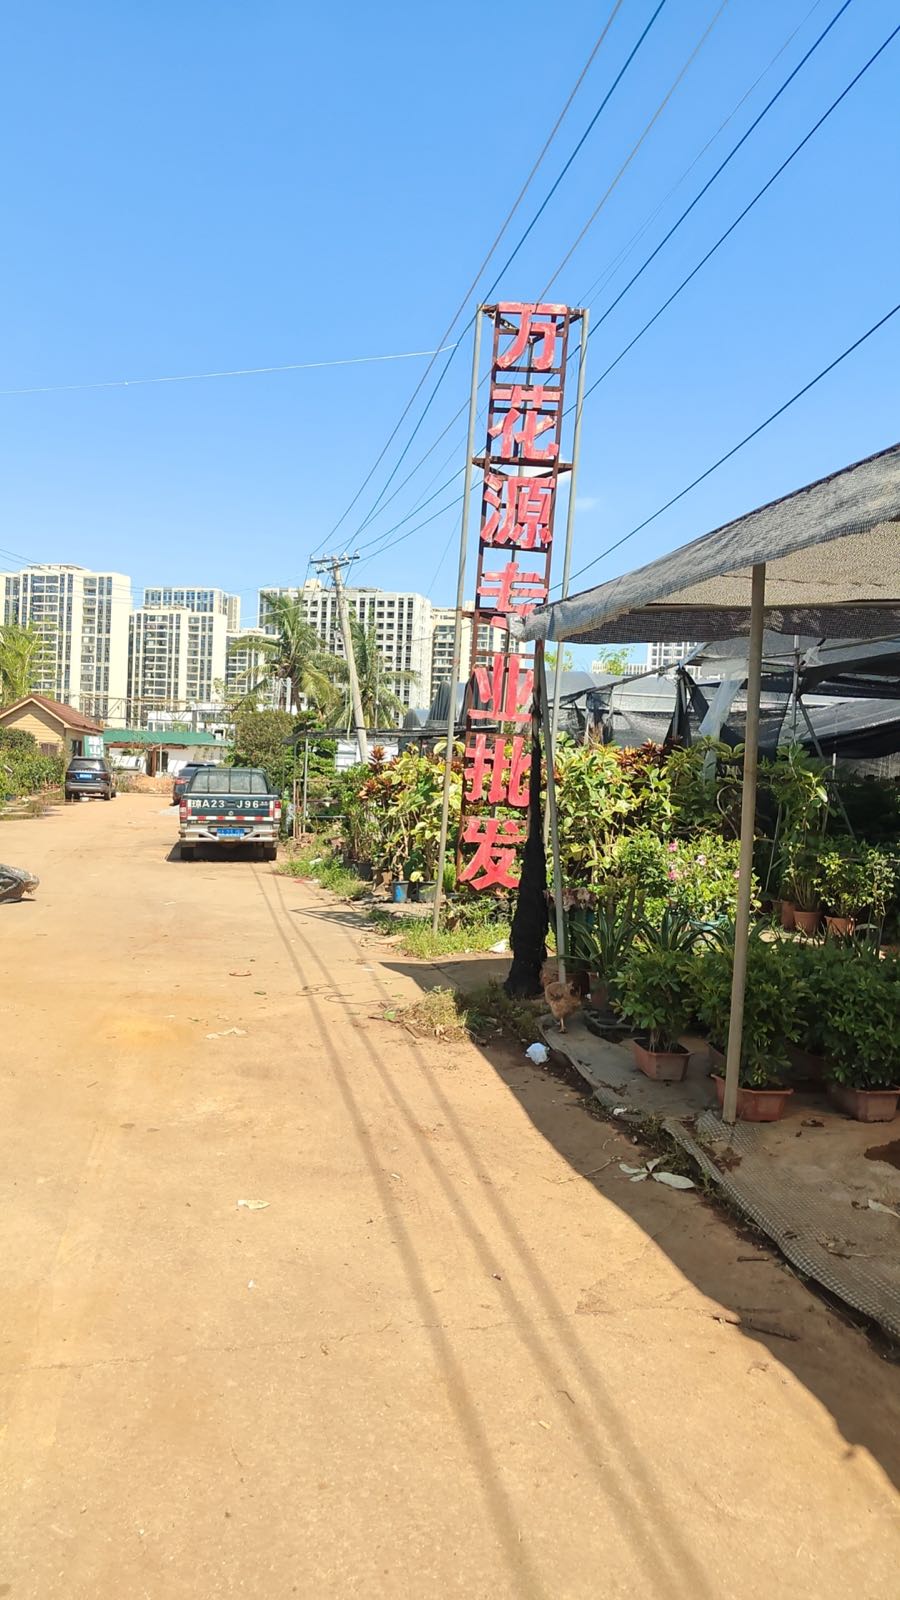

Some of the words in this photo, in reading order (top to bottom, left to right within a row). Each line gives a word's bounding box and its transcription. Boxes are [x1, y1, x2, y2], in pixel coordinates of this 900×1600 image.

[458, 302, 568, 890] 万花源专业批发
